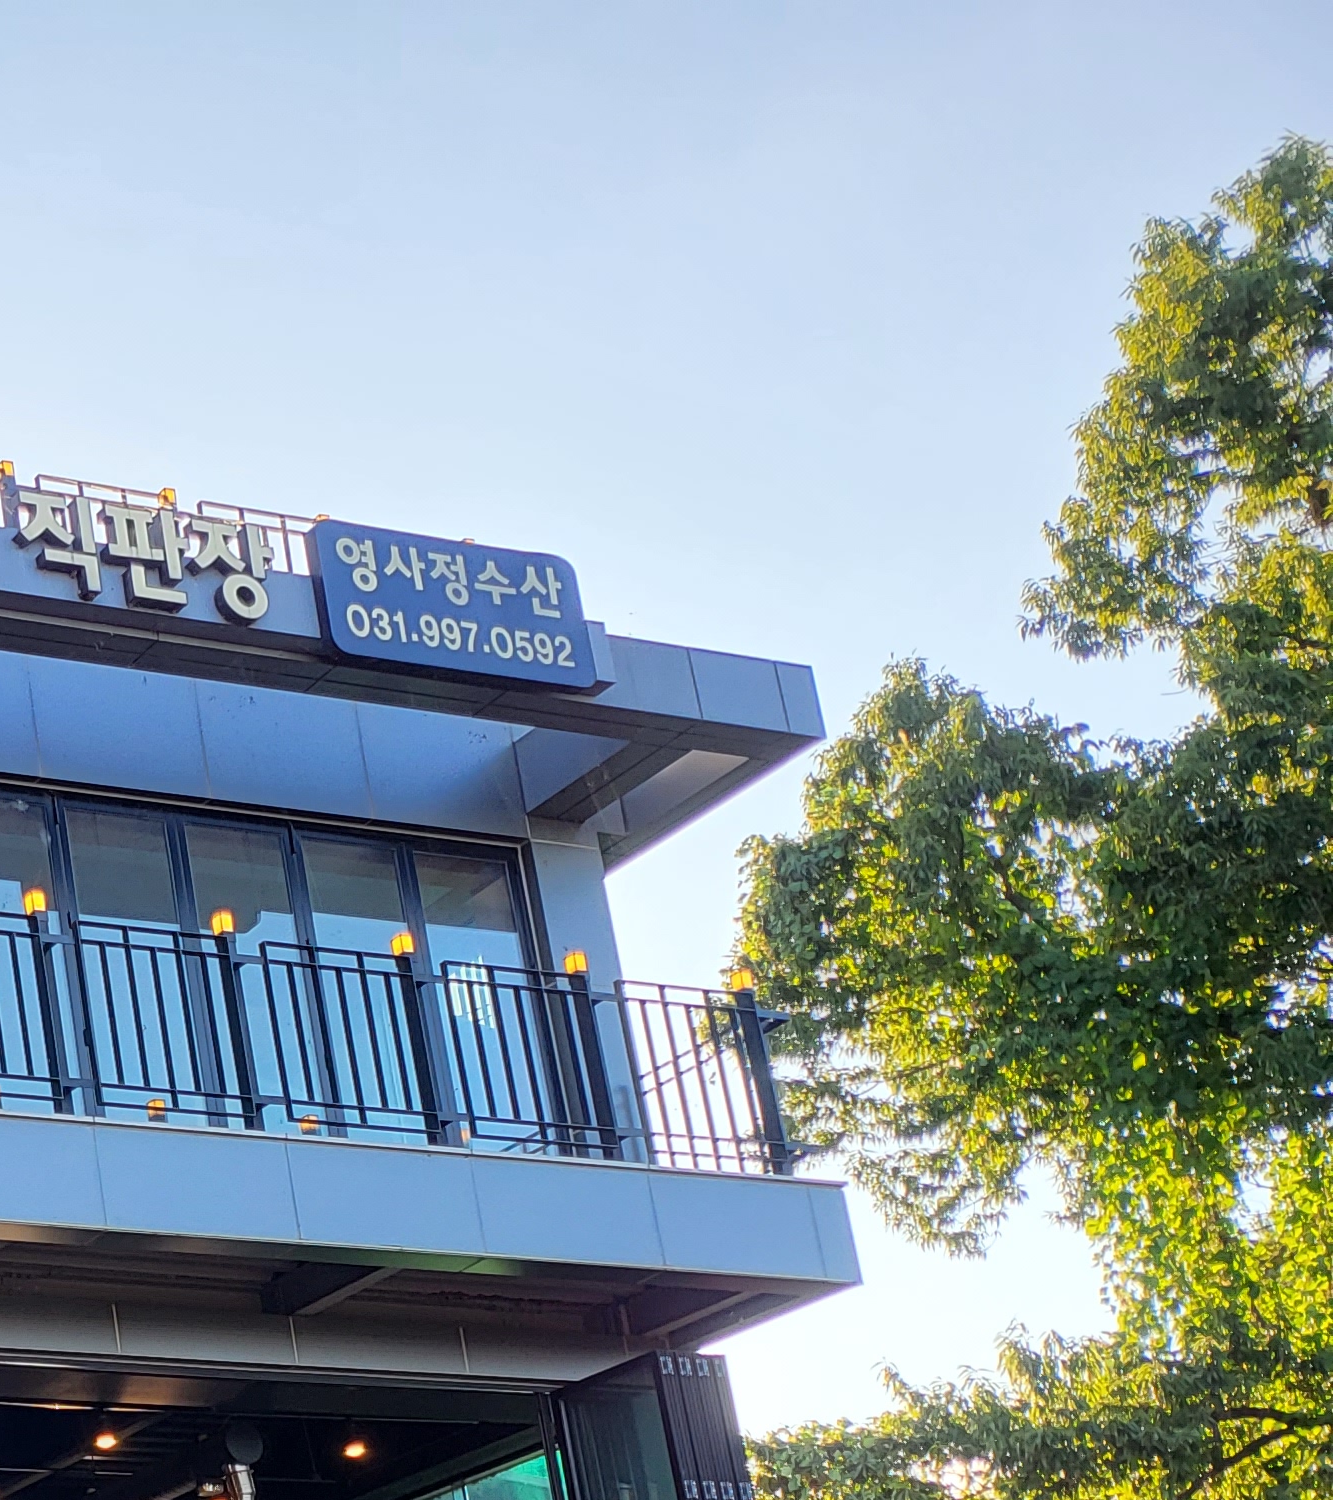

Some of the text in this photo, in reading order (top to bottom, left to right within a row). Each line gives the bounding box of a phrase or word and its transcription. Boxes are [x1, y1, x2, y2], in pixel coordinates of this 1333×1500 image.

[14, 488, 275, 625] 직판장
[335, 535, 562, 619] 영사정수산
[346, 603, 576, 669] 031.997.0592
